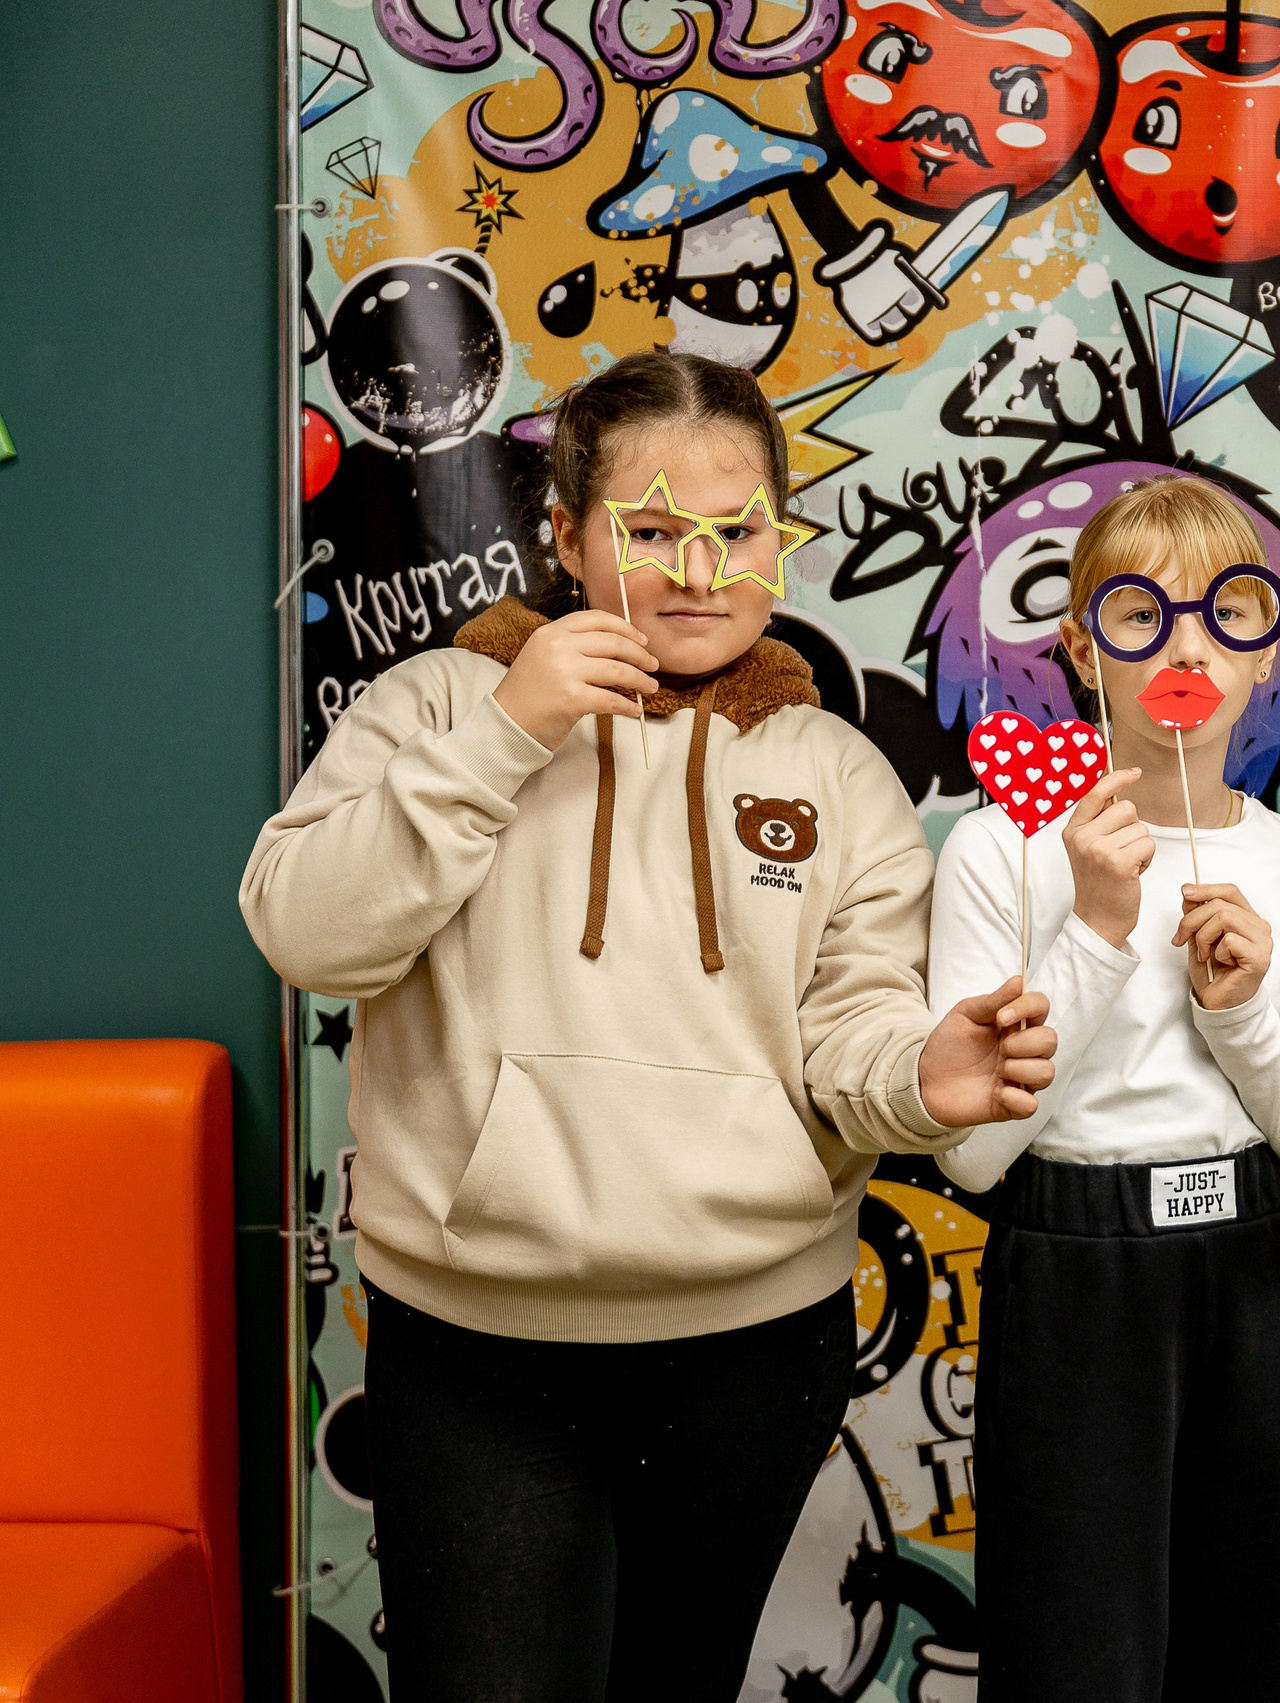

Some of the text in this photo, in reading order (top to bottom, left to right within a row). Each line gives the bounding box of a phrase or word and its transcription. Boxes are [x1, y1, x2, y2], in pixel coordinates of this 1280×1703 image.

[334, 540, 528, 660] Крутая
[759, 863, 795, 880] RELAX
[750, 875, 802, 893] MOOD ON
[1166, 1193, 1225, 1218] HAPPY
